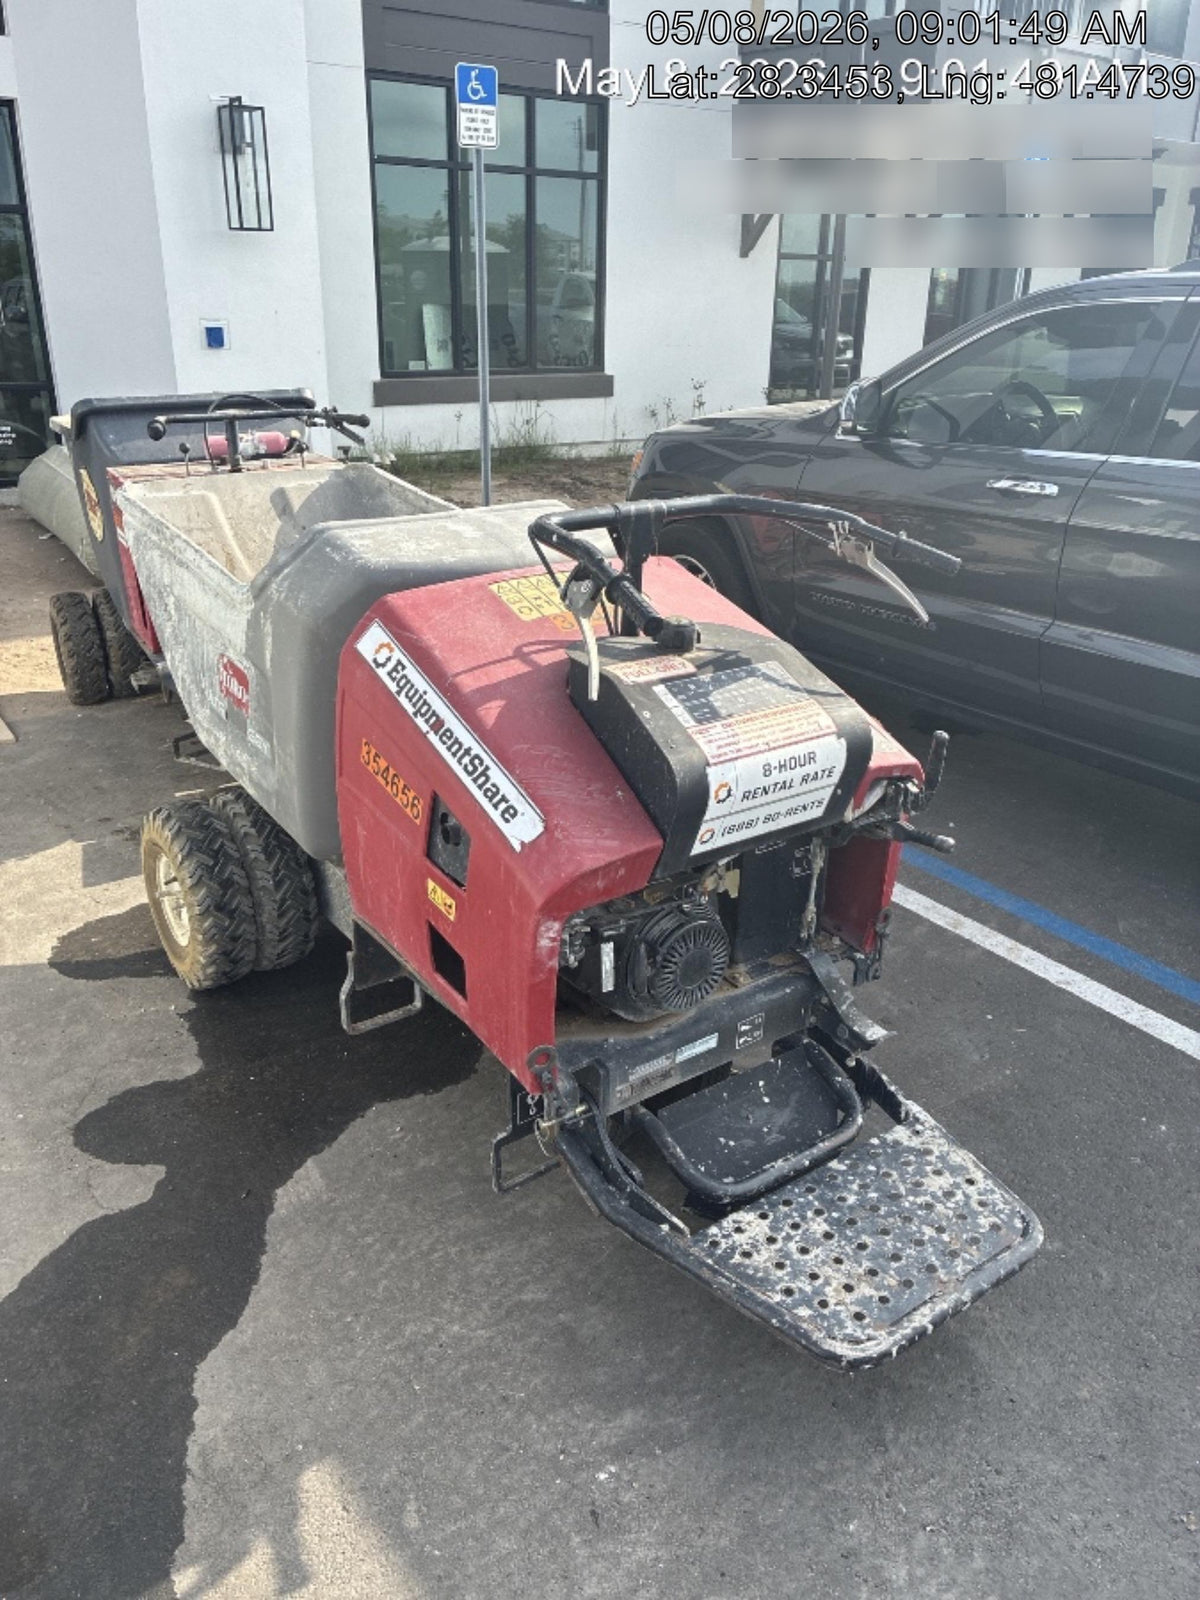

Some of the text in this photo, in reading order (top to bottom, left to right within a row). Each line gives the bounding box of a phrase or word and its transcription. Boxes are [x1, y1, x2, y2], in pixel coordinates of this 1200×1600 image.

[387, 660, 519, 824] EquipmentShare
[361, 741, 422, 821] 354656
[762, 751, 817, 778] 8-HOUR
[741, 765, 837, 802] RENTAL RATE
[762, 797, 826, 824] 80-RENTS
